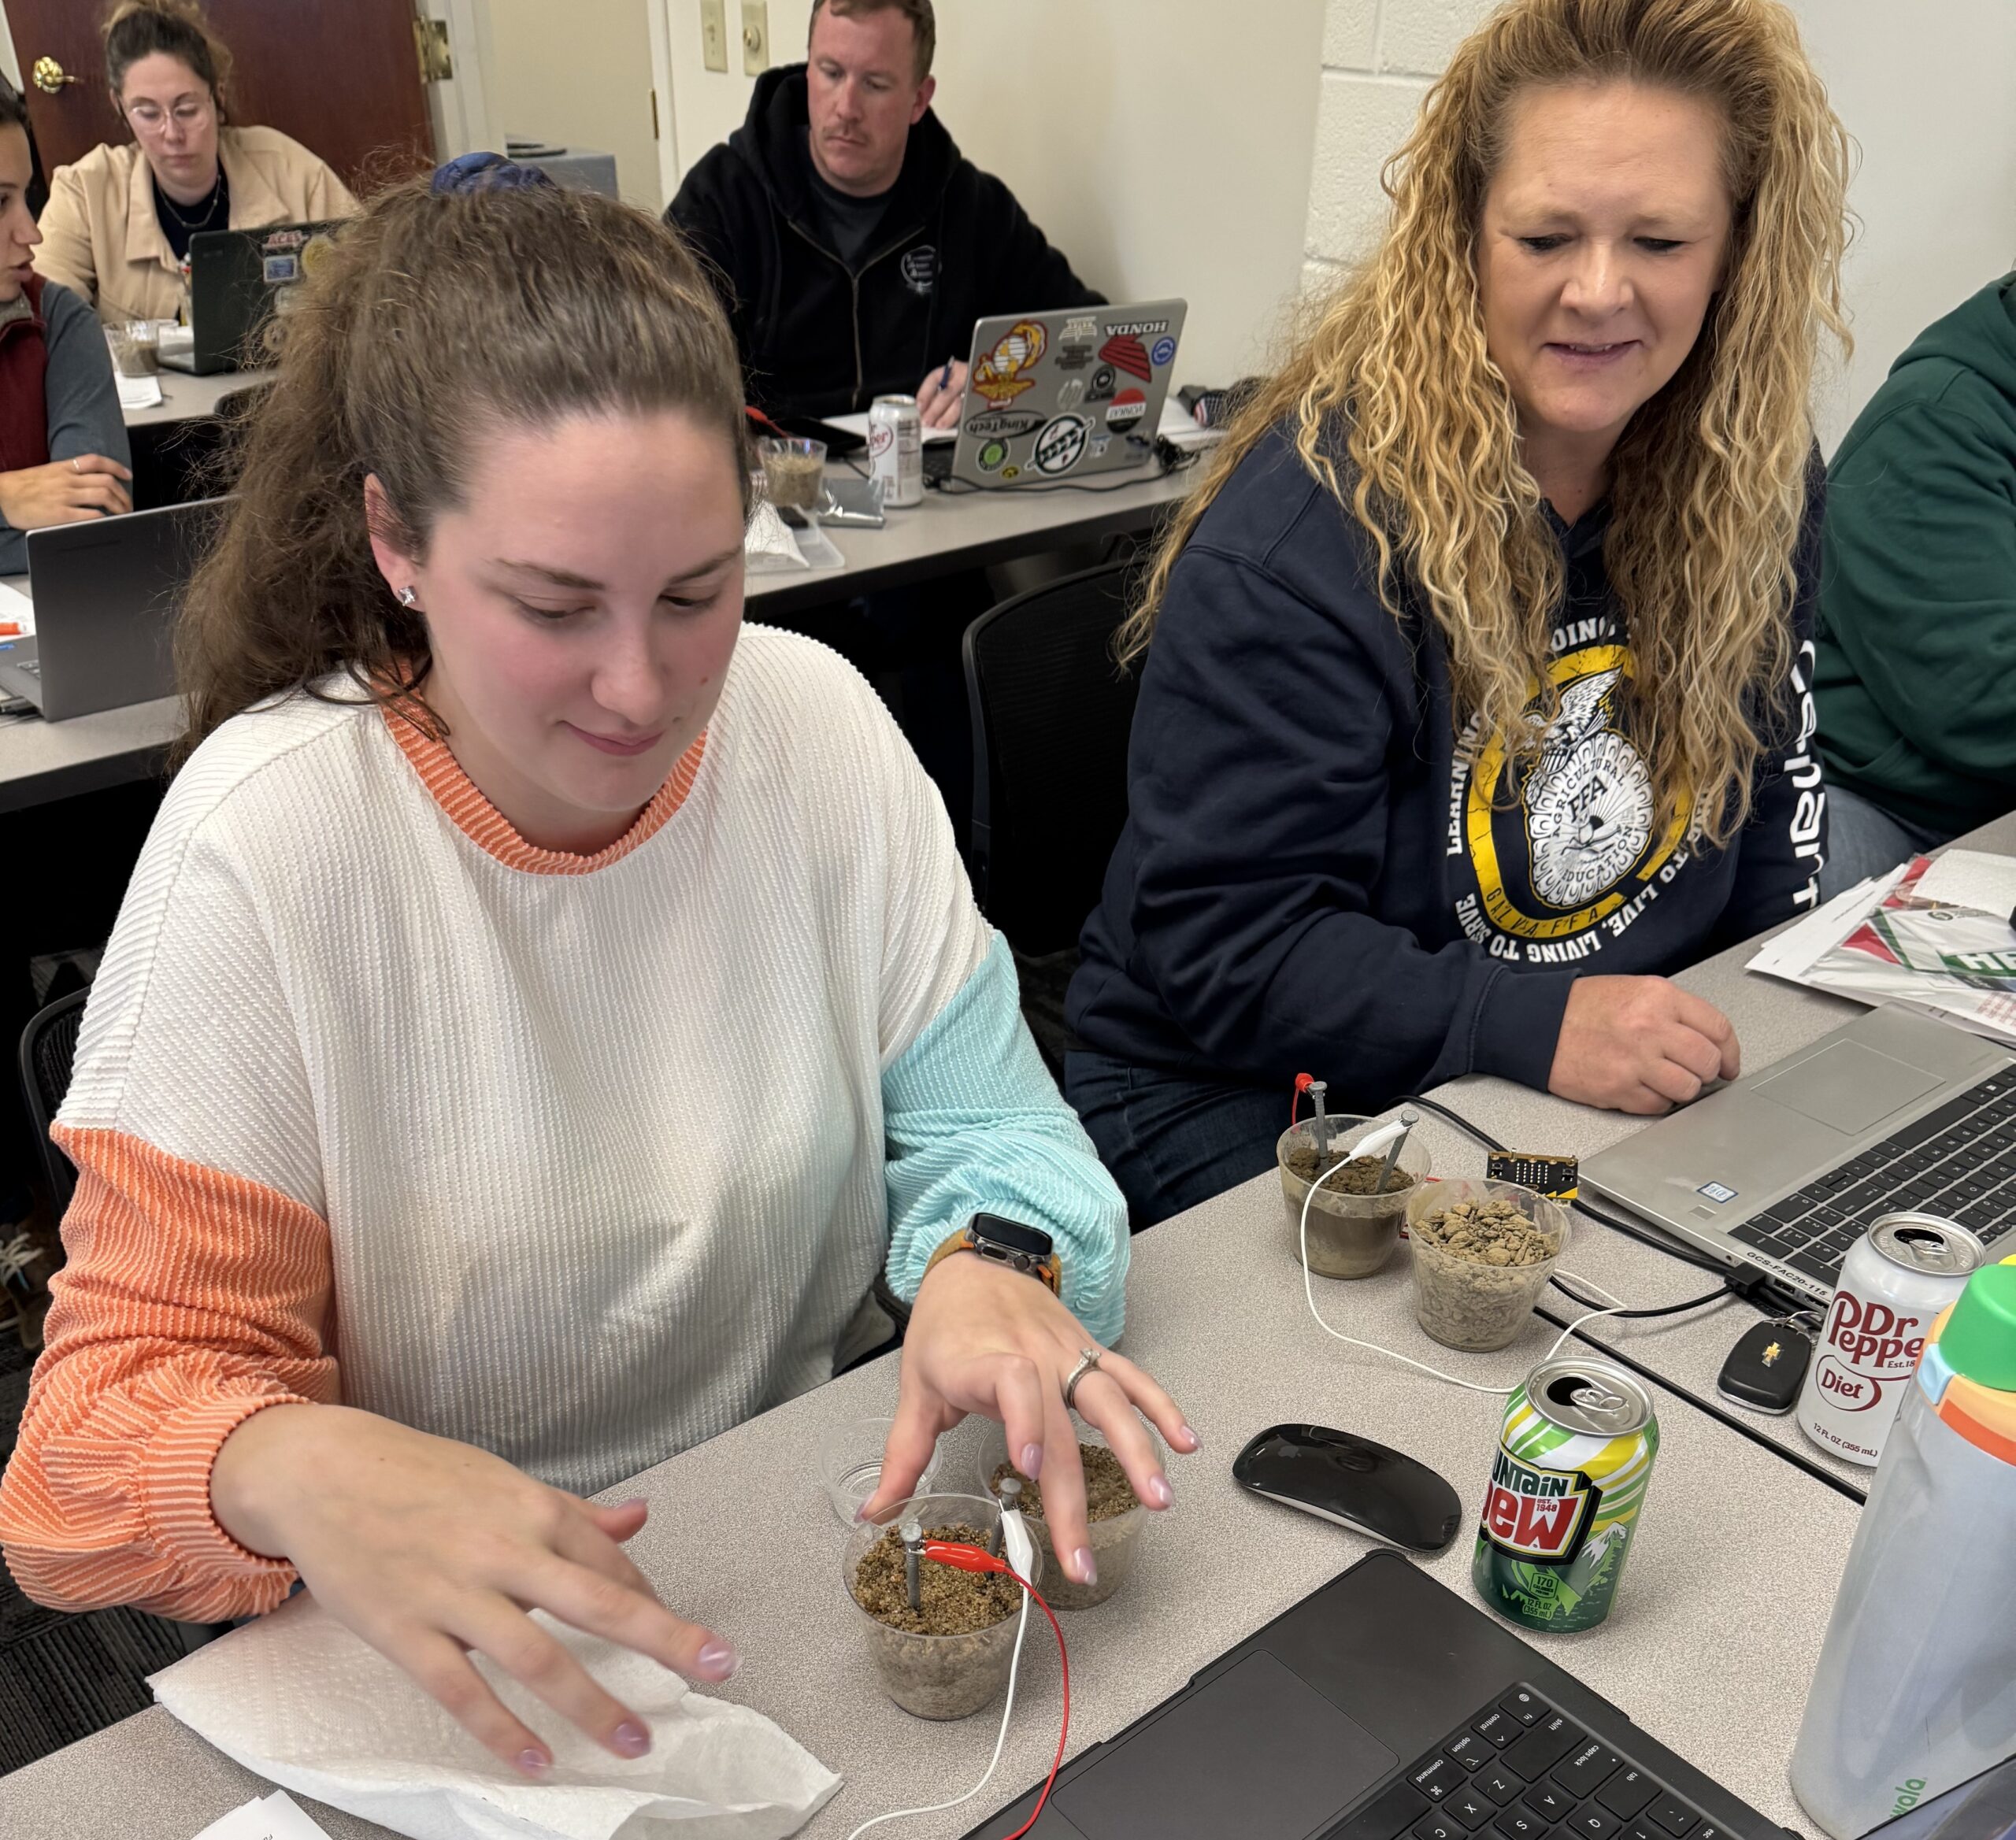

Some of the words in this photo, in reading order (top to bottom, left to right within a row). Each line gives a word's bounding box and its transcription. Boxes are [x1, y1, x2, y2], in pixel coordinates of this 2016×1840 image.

[1106, 321, 1167, 336] HONDA
[1551, 616, 1616, 652] OING
[1552, 758, 1625, 837] AGRICULTURAL
[1567, 775, 1608, 824] FFA
[1562, 826, 1633, 883] EDUCATION
[1486, 887, 1538, 937] GALVA
[1551, 907, 1598, 935] FFA
[1601, 883, 1659, 938] LIVE,
[1489, 935, 1520, 961] TO
[1526, 930, 1603, 963] LIVING
[1858, 1301, 1918, 1338] Dr
[1827, 1290, 1925, 1368] Peppe
[1821, 1368, 1863, 1398] Diet
[1814, 1423, 1821, 1433] 12
[1821, 1429, 1829, 1439] FL
[1830, 1435, 1842, 1446] OZ
[1842, 1442, 1861, 1453] (355
[1861, 1448, 1878, 1457] mL)
[1537, 1576, 1553, 1588] 170
[1528, 1598, 1534, 1607] 12
[1524, 1605, 1538, 1615] (355
[1540, 1611, 1552, 1620] mL)
[1480, 1713, 1500, 1731] control
[1548, 1718, 1562, 1731] shift
[1451, 1737, 1471, 1753] option
[1585, 1745, 1599, 1757] caps
[1574, 1754, 1588, 1766] lock
[1416, 1759, 1443, 1783] command
[1626, 1772, 1638, 1781] tab
[1493, 1779, 1505, 1790] Z
[1544, 1795, 1555, 1805] A
[1889, 1779, 1927, 1817] wala
[1464, 1803, 1477, 1814] X
[1516, 1820, 1527, 1830] S
[1588, 1819, 1600, 1828] Q
[1435, 1828, 1446, 1838] C
[1703, 1828, 1714, 1838] esc
